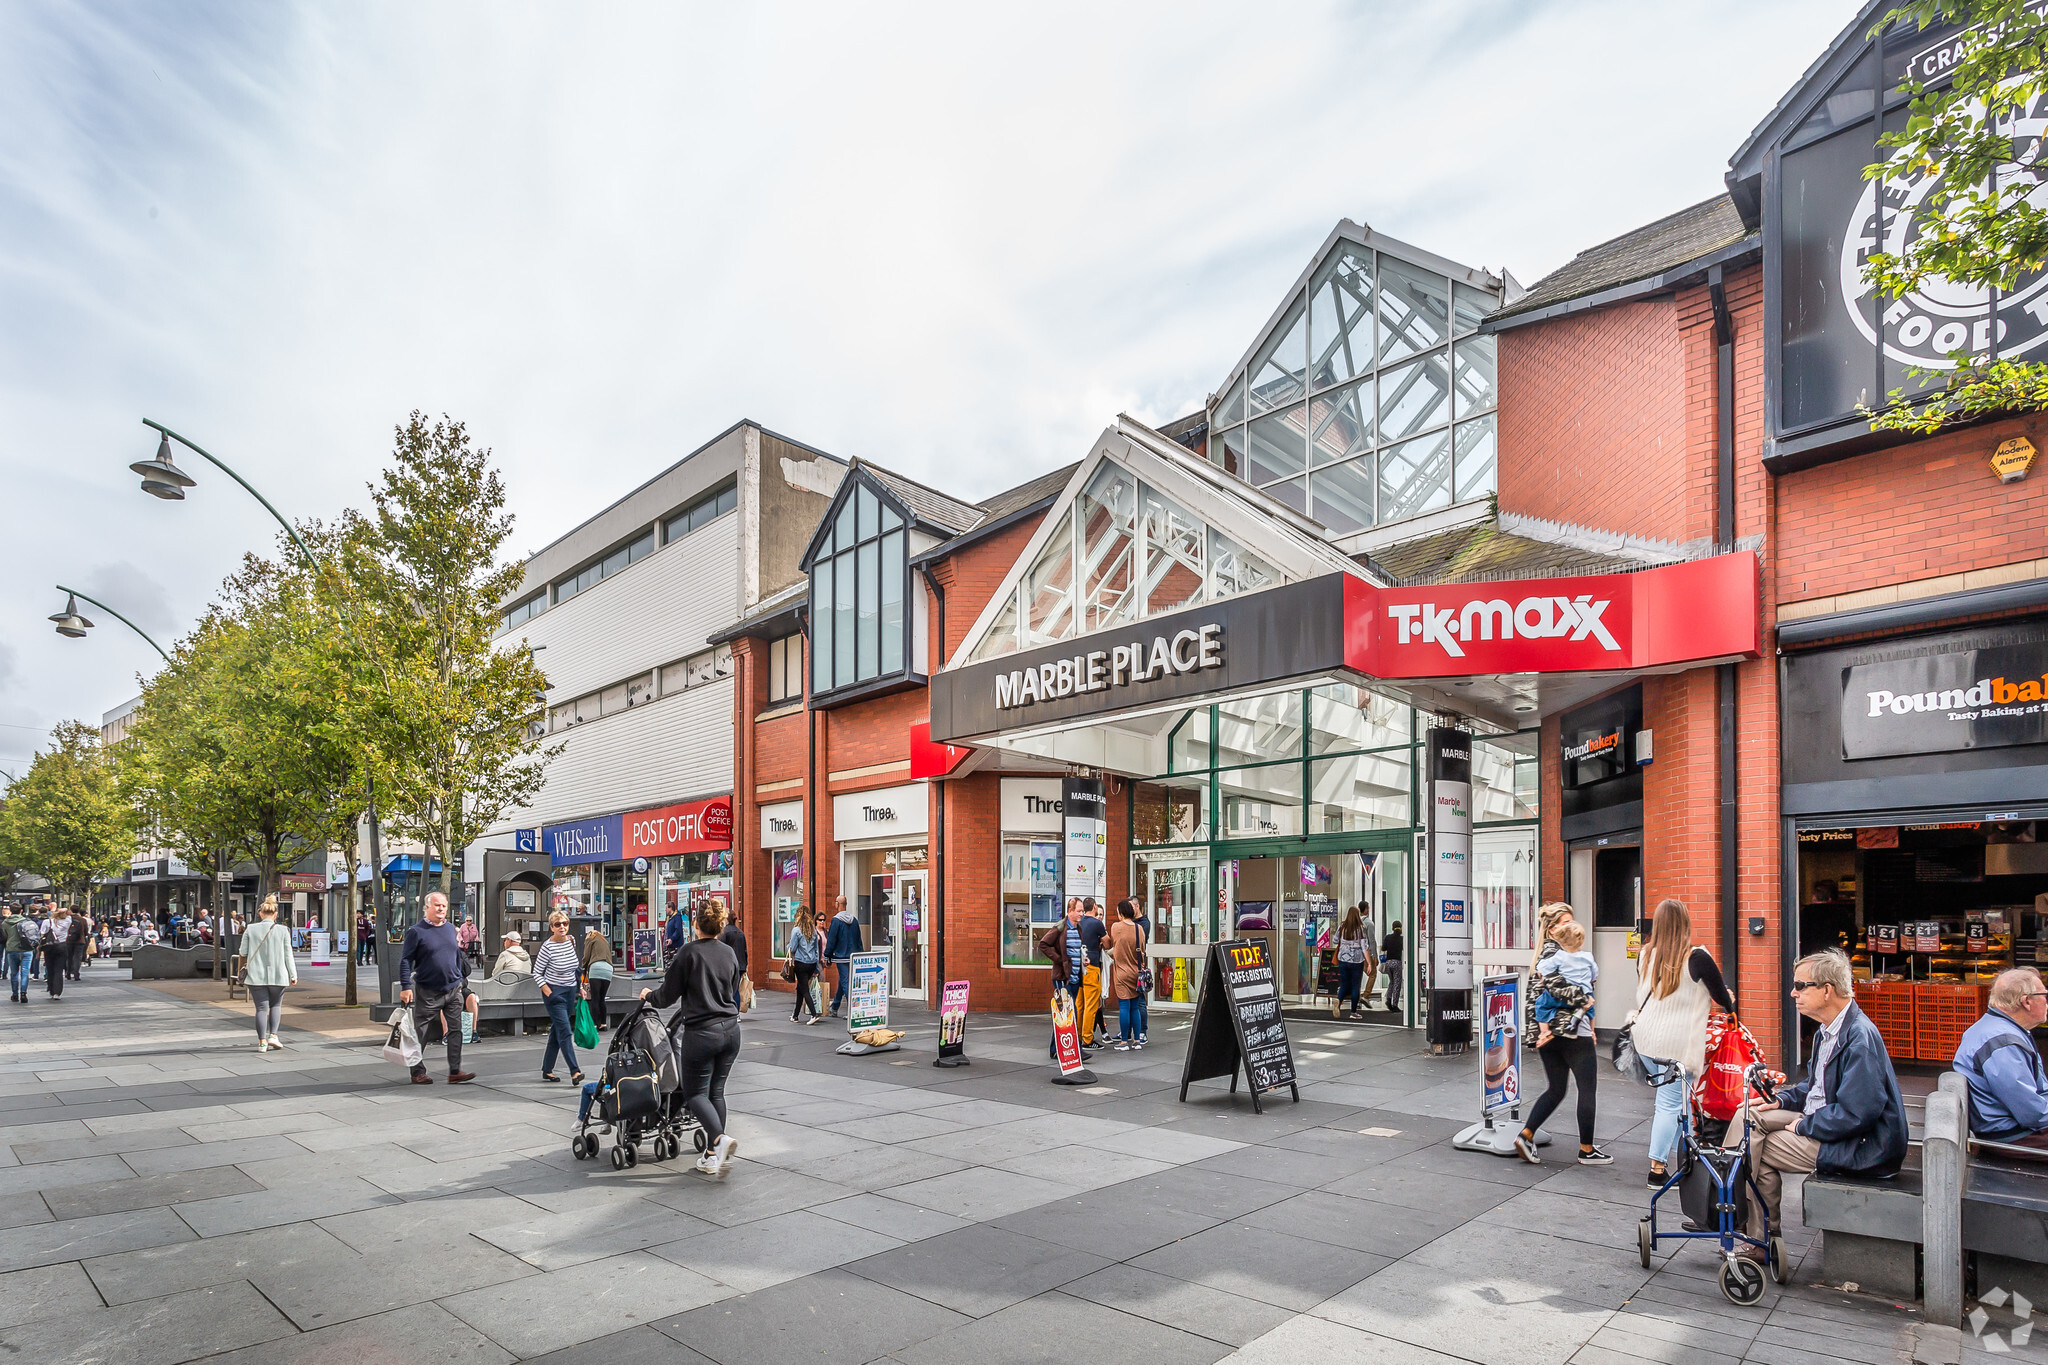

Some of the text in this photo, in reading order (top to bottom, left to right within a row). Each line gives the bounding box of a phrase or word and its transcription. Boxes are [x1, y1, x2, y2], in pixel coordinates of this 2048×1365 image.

[1883, 299, 2007, 355] FOOD
[1997, 445, 2030, 457] Modern
[1999, 455, 2029, 466] Alarms
[995, 623, 1221, 710] MARBLE PLACE
[1947, 711, 1979, 721] Tasty
[1981, 707, 2024, 718] Baking
[2025, 704, 2040, 713] at
[1564, 732, 1620, 761] Poundbakery
[1441, 748, 1469, 761] MARBLE
[1023, 795, 1063, 813] Thre
[1071, 792, 1107, 805] MARBLE PLA
[1437, 797, 1460, 806] Marble
[711, 808, 729, 817] POST
[1452, 807, 1466, 817] News
[707, 816, 731, 825] OFFICE
[520, 831, 533, 839] WH
[633, 811, 712, 847] POST OFFIC
[1071, 831, 1091, 839] savers
[553, 825, 609, 858] WHSmith
[1822, 832, 1853, 841] Prices
[1441, 850, 1465, 860] savers
[284, 879, 313, 891] Pippins
[1444, 902, 1462, 911] Shoe
[1444, 912, 1463, 920] Zone
[1879, 928, 1896, 939] £1
[1970, 928, 1983, 937] £1
[853, 956, 888, 965] MARBLE NEWS
[1229, 971, 1246, 984] CAFE
[1249, 967, 1272, 982] BISTRO
[945, 989, 967, 1001] THICK
[1240, 1001, 1277, 1021] BREAKFAST
[1442, 1010, 1470, 1020] MARBLE
[1494, 1015, 1507, 1027] DEAL
[1247, 1031, 1261, 1048] FISH
[1266, 1023, 1282, 1039] CHIPS
[1505, 1076, 1517, 1095] £2
